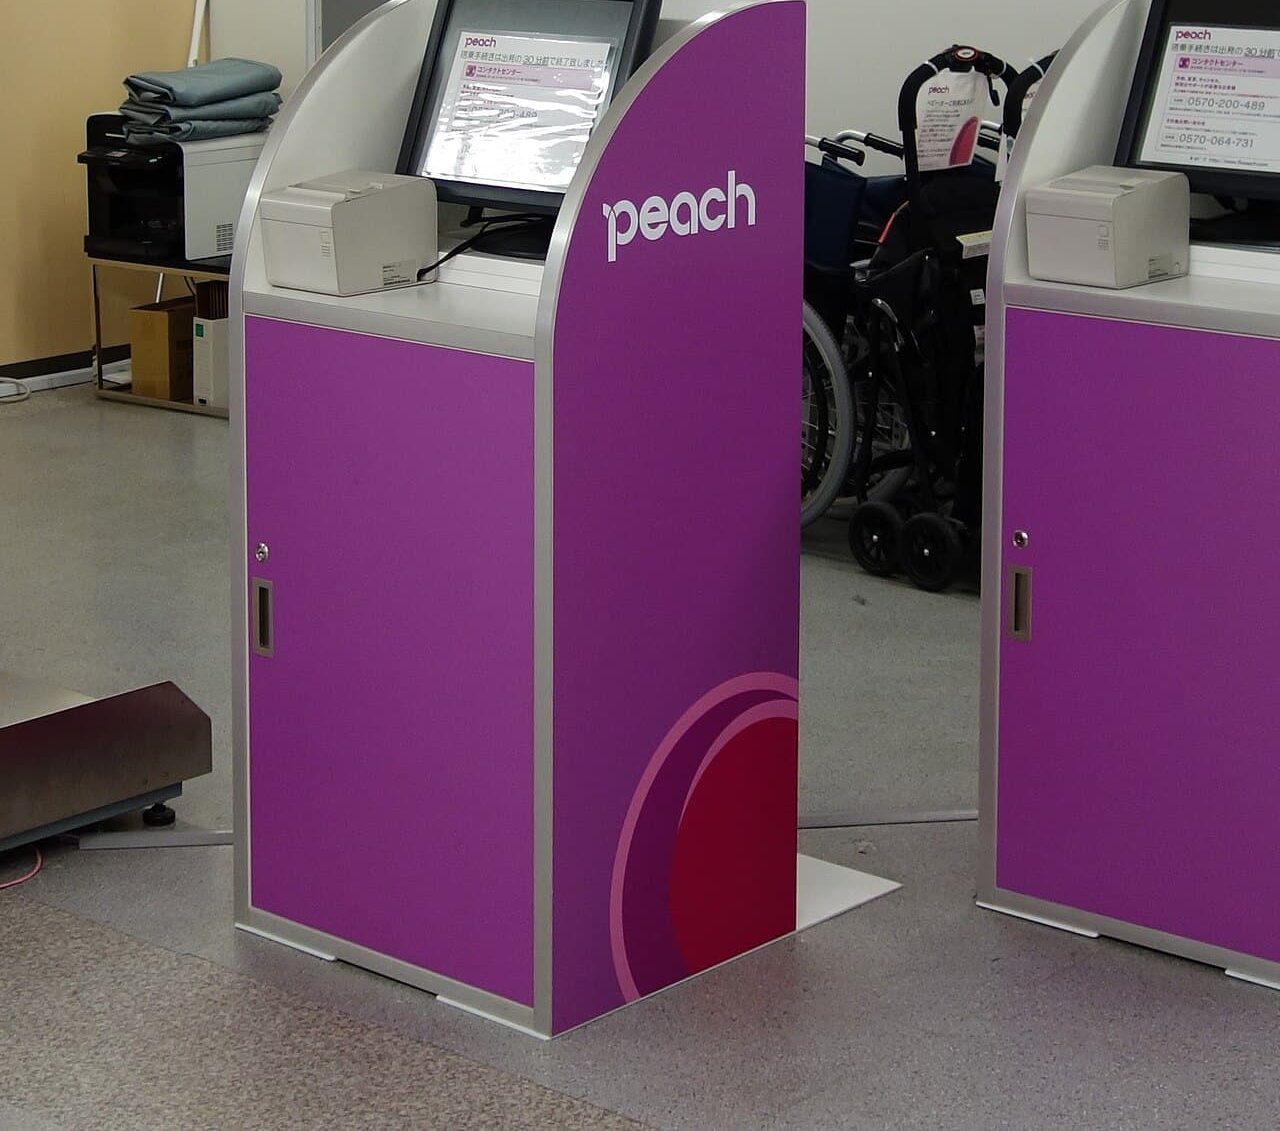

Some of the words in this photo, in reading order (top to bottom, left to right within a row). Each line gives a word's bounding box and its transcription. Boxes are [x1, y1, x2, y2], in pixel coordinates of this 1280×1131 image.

[1175, 29, 1211, 40] peach
[465, 37, 496, 48] peach
[1191, 58, 1243, 66] コンタクトセンター
[477, 66, 522, 75] コンタクトセンター
[1187, 97, 1265, 110] 0570-200-489
[1179, 133, 1254, 148] 0570-064-731
[602, 170, 756, 262] peach
